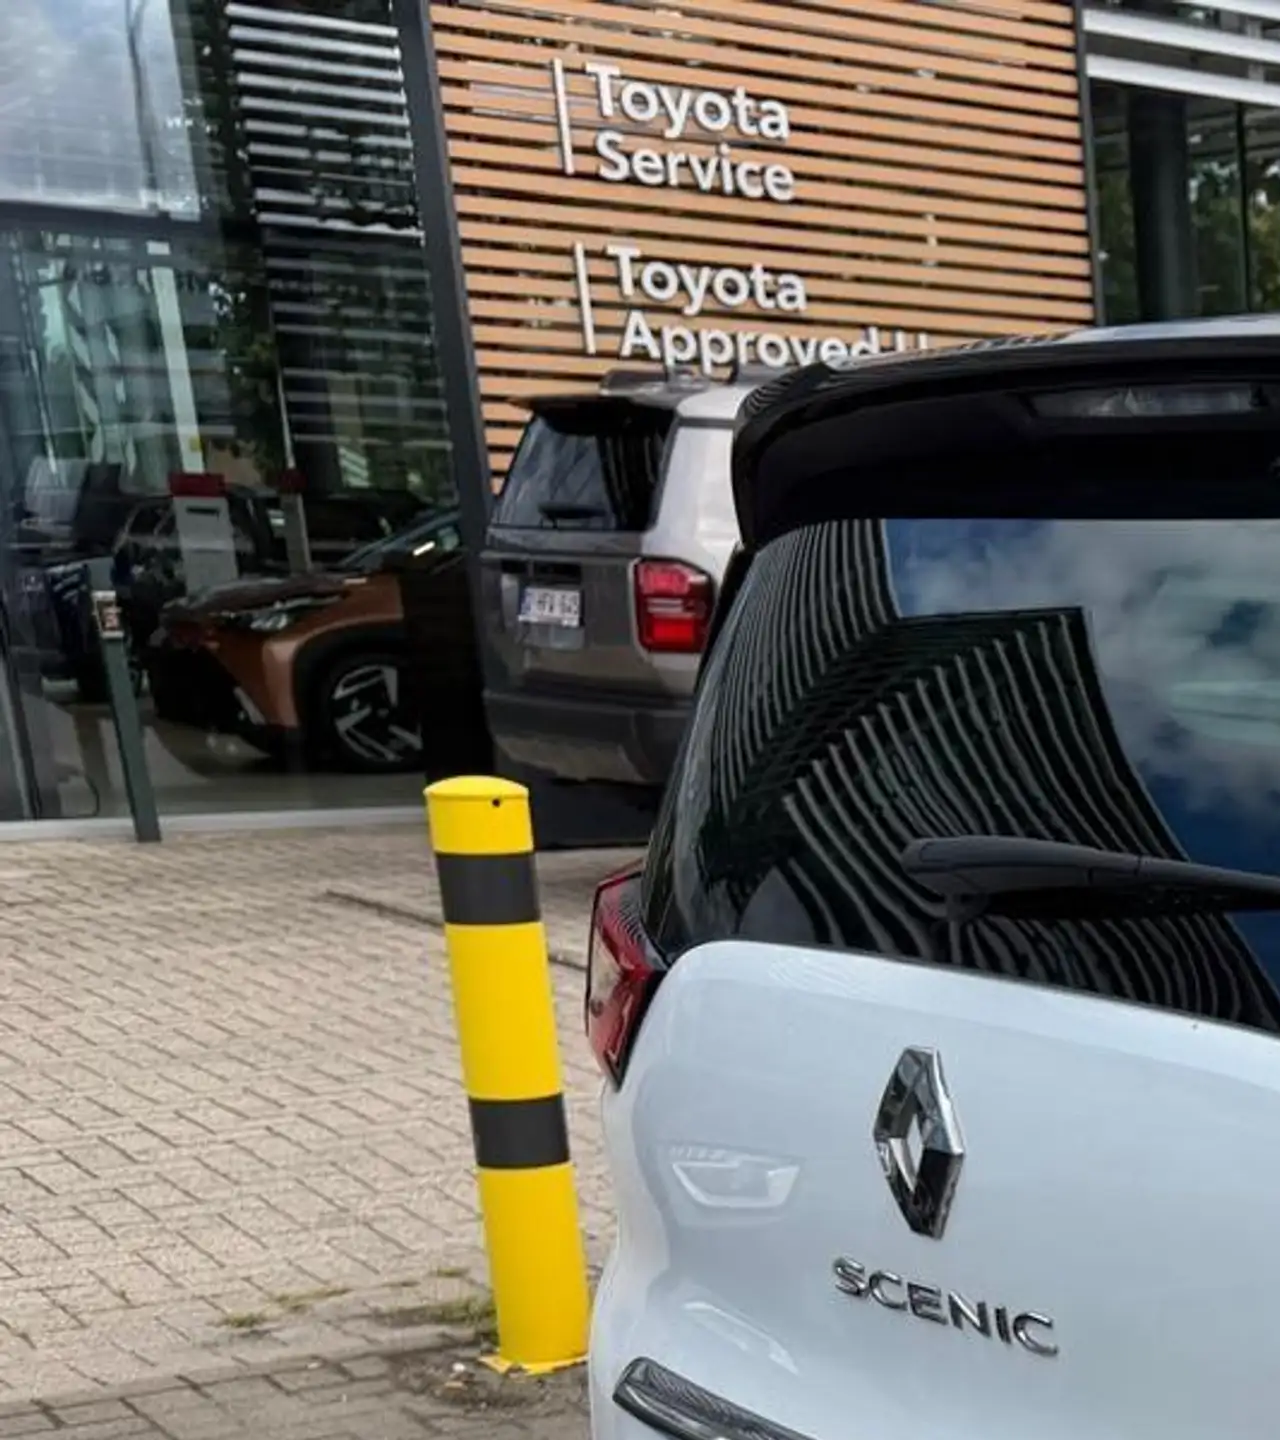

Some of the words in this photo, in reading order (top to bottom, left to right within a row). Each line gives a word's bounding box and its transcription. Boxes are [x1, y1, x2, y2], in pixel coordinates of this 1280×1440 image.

[585, 62, 789, 141] Toyota
[596, 131, 795, 201] Service
[606, 243, 808, 316] Toyota
[832, 1256, 1060, 1356] SCENIC
